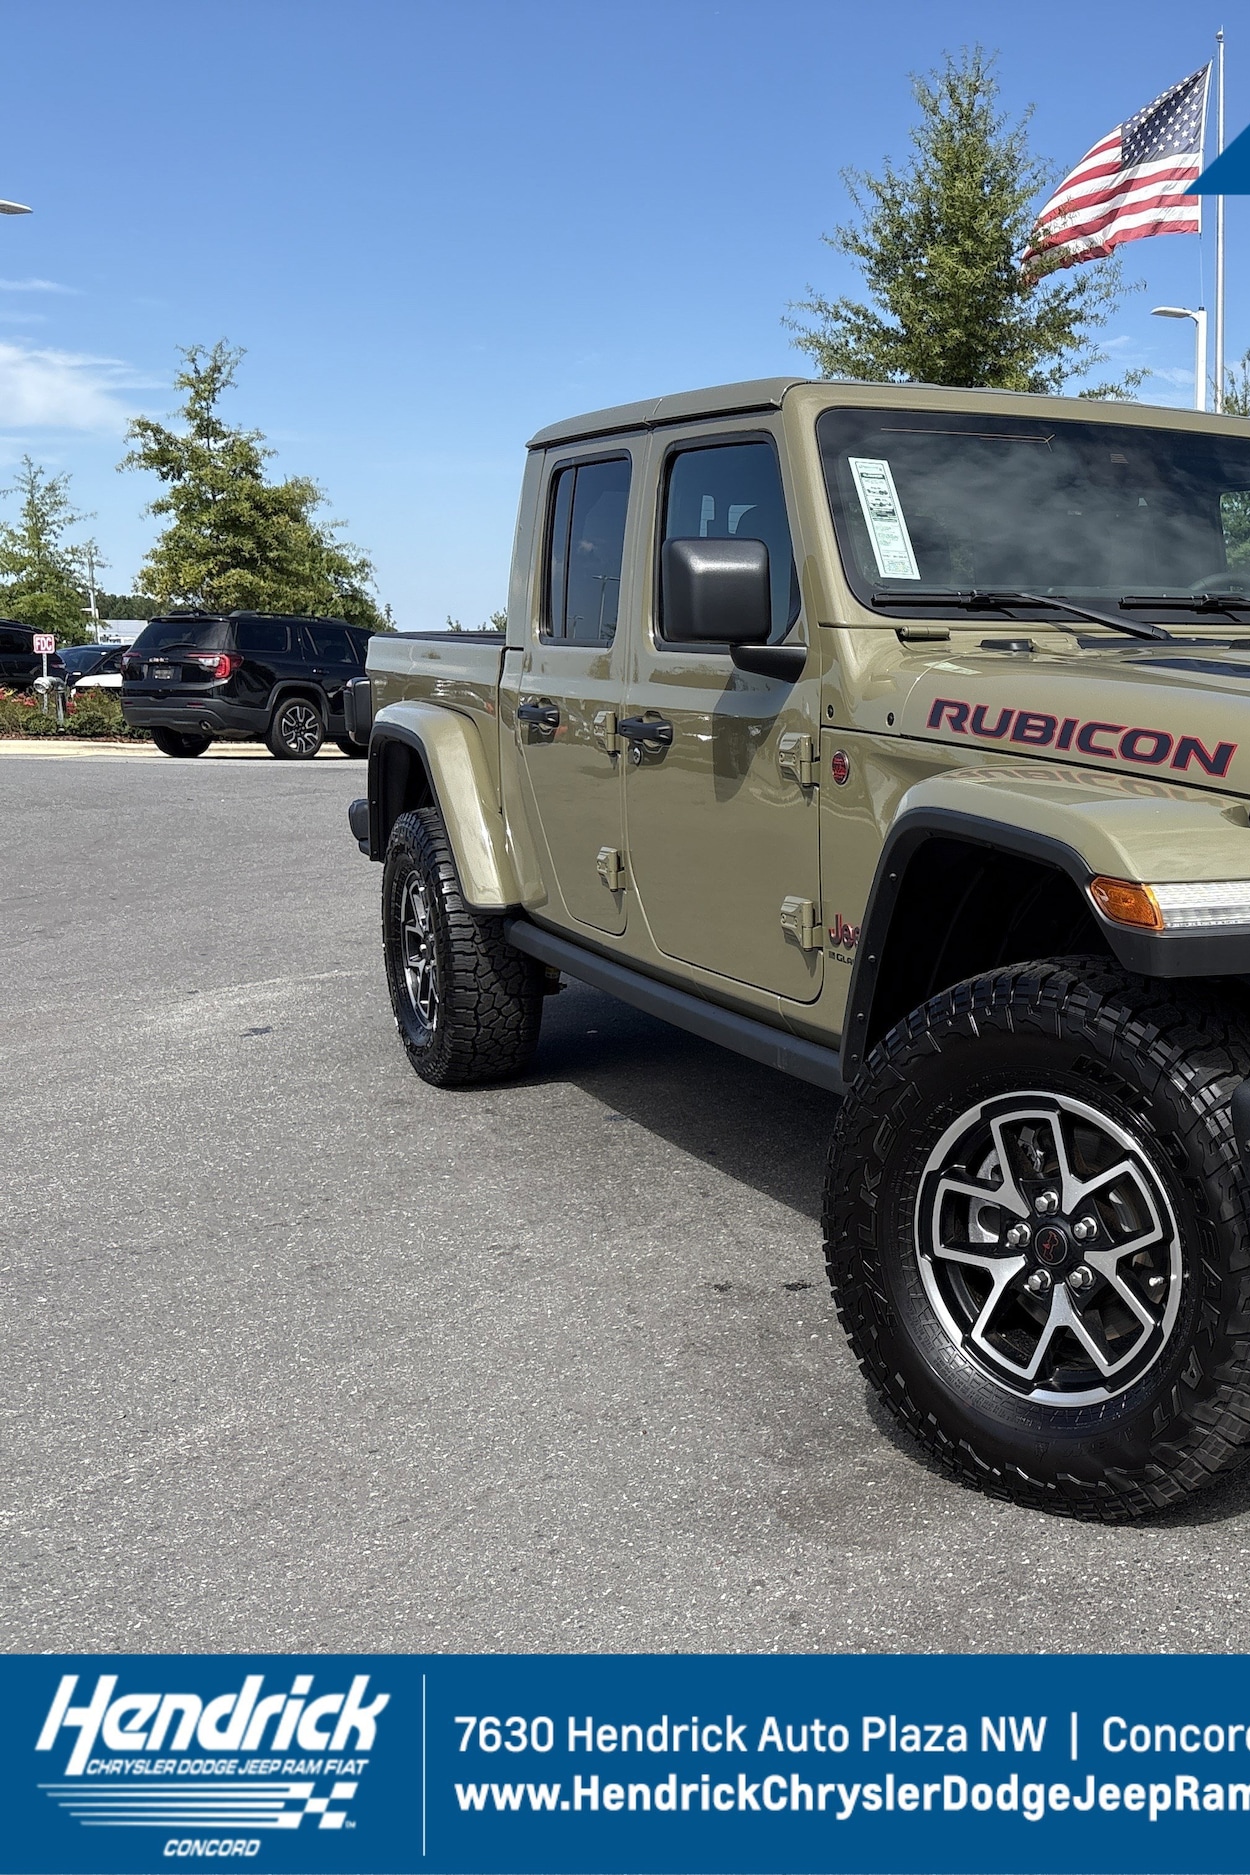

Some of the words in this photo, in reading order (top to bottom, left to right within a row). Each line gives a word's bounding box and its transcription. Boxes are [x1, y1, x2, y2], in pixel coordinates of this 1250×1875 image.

[35, 637, 52, 651] FDC
[926, 697, 1239, 778] RUBICON
[858, 1081, 924, 1328] FALKEN
